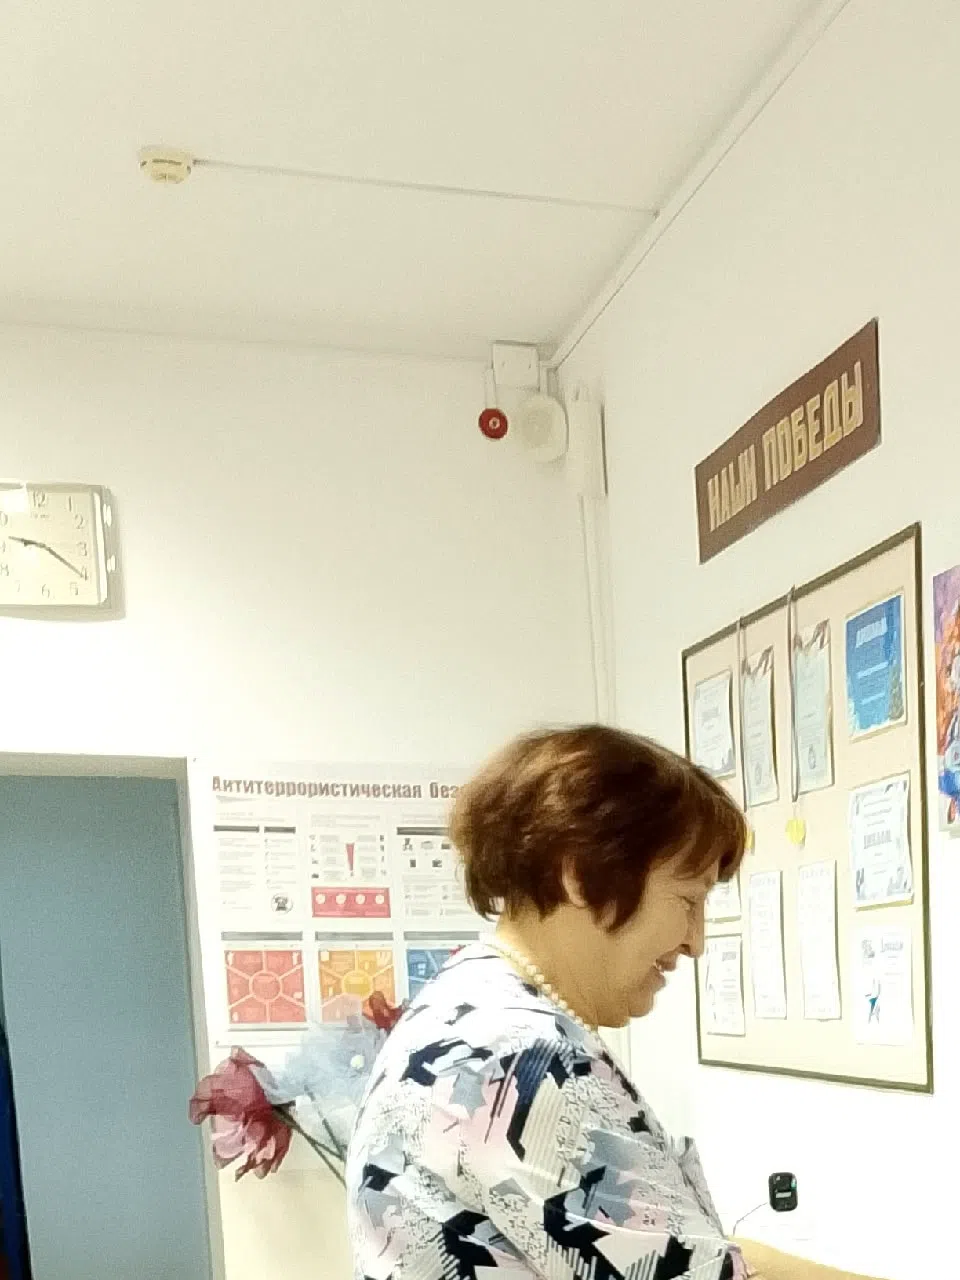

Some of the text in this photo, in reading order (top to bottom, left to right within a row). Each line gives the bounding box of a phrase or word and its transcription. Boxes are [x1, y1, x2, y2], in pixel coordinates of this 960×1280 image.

[706, 360, 864, 532] НАШИ ПОБЕДЫ
[212, 775, 422, 799] Антитеррористическая
